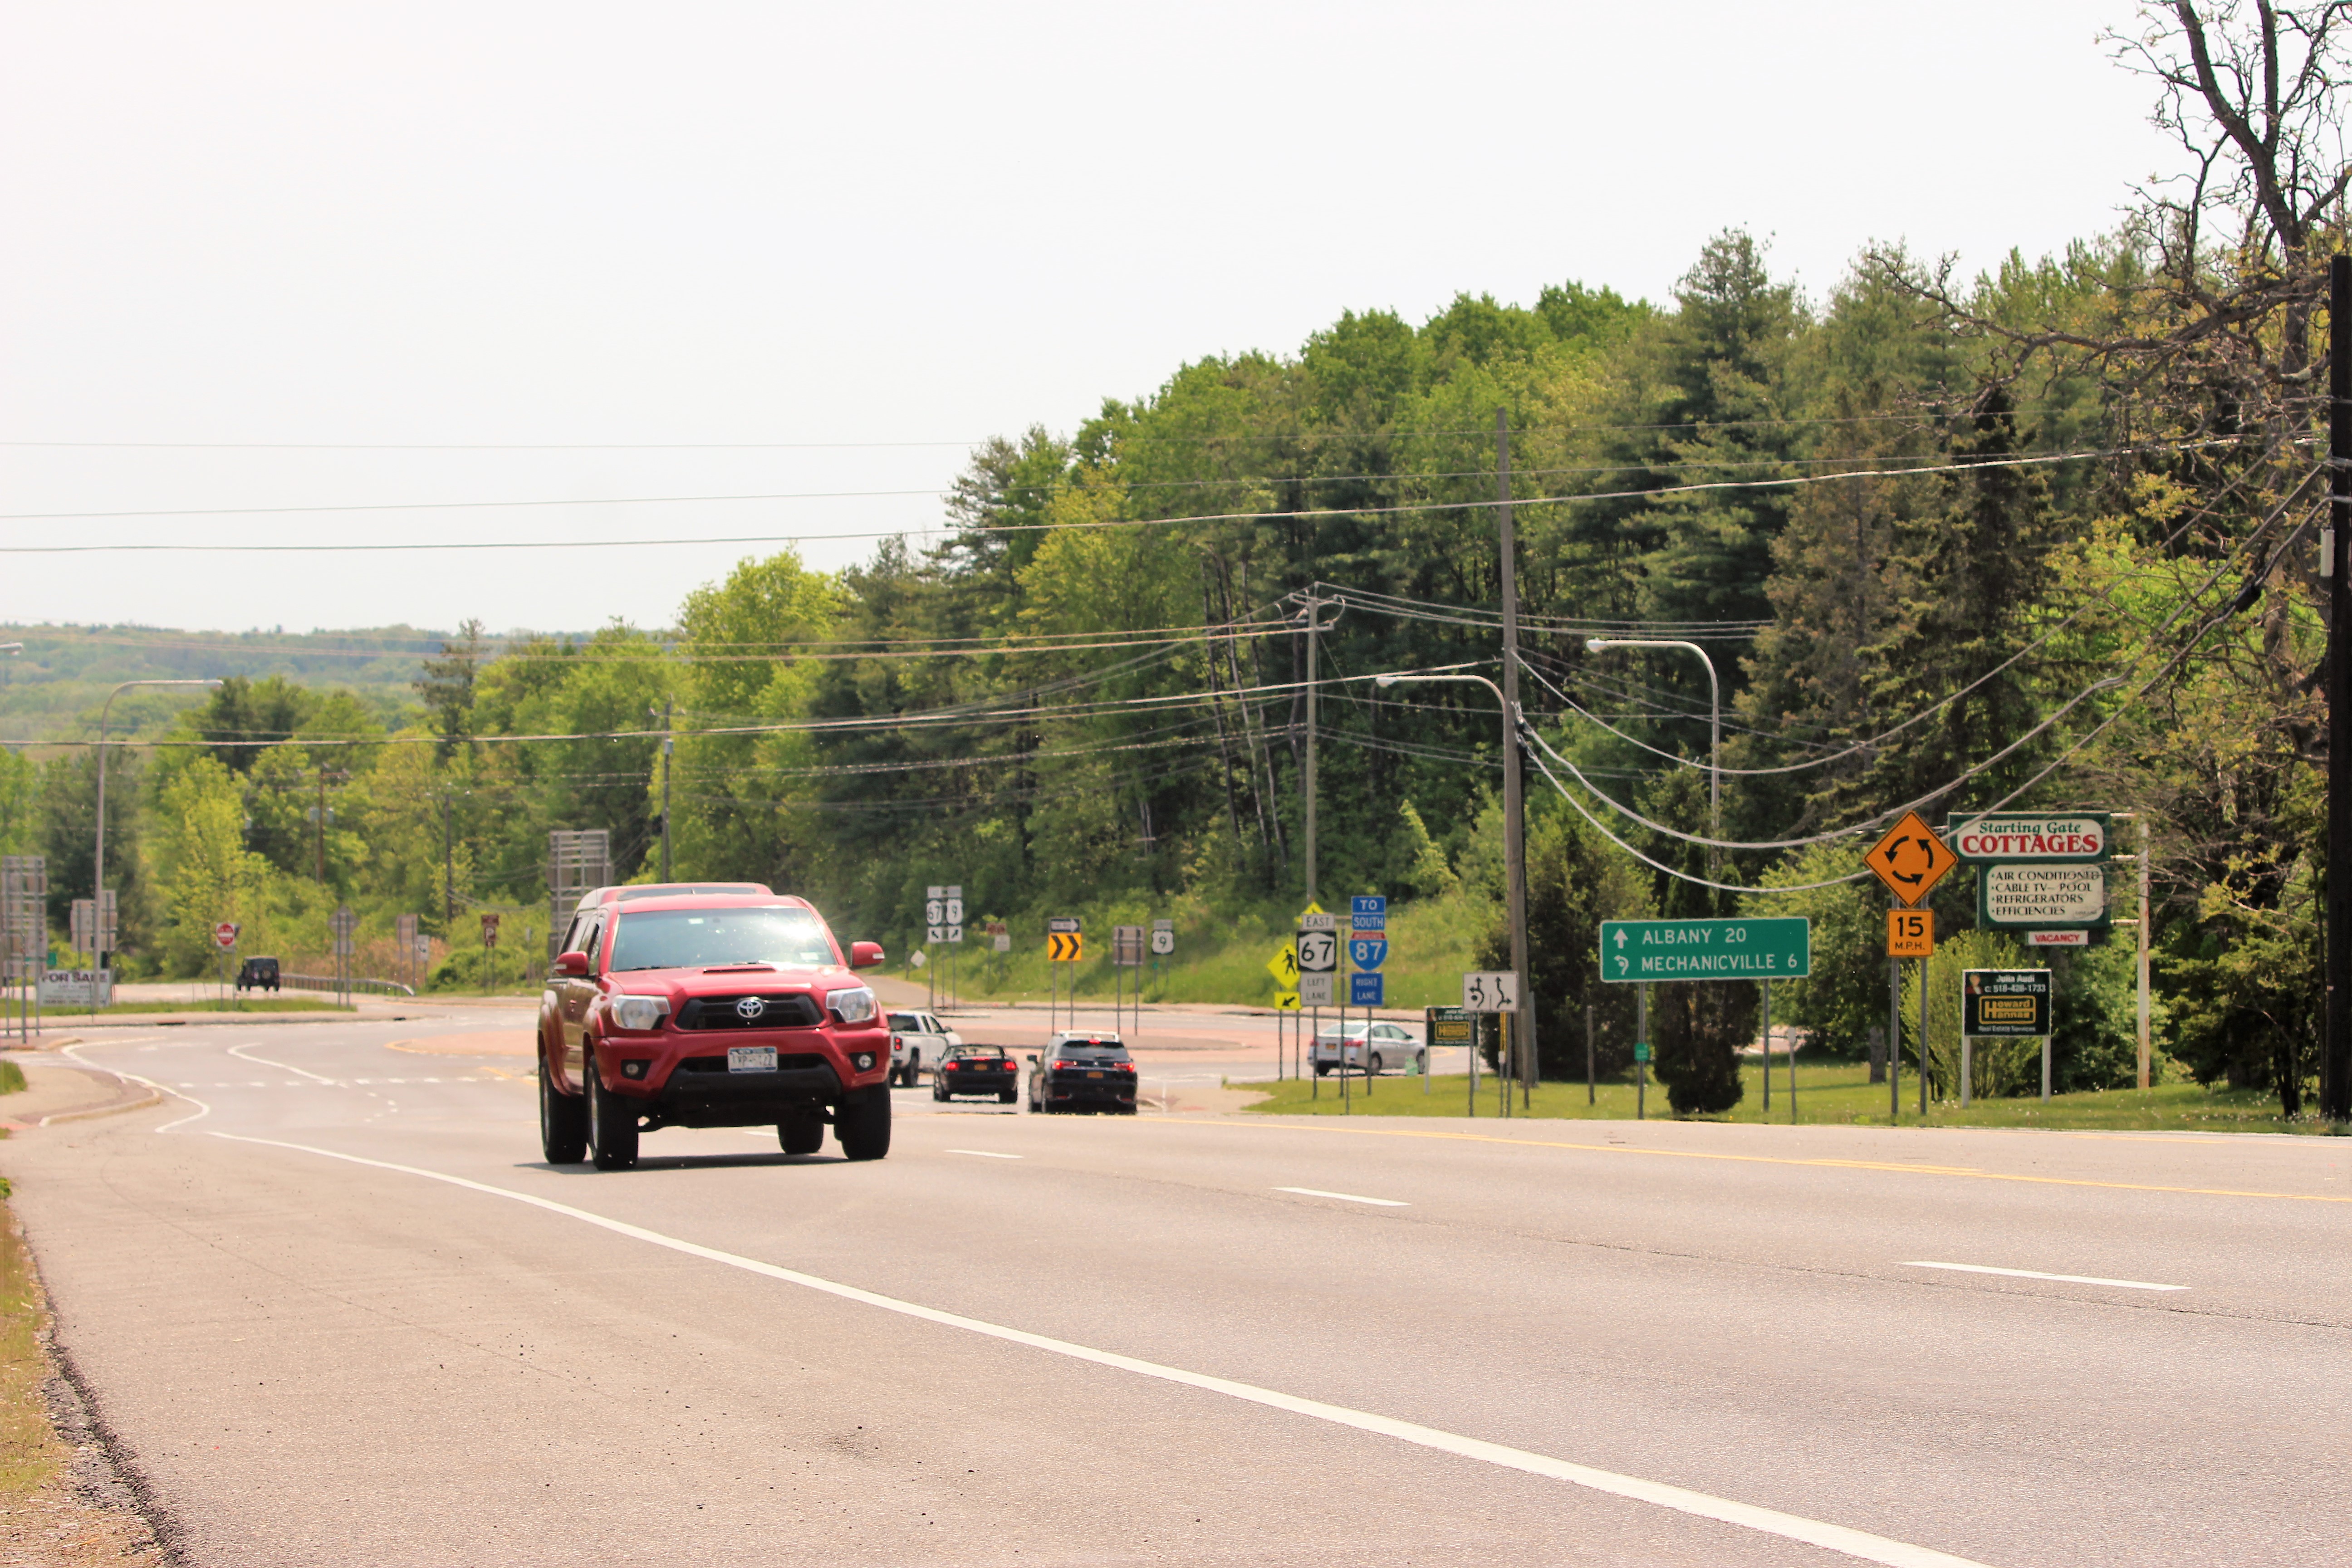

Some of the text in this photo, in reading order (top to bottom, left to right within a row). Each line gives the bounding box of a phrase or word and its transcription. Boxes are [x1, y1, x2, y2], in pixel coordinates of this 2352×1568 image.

[1980, 822, 2081, 835] Starting Gate
[1962, 834, 2098, 853] COTTAGES
[1996, 870, 2100, 881] AIR CONDITIONED
[1995, 883, 2029, 892] CABLE
[2060, 882, 2092, 892] POOL
[1360, 899, 1377, 911] TO
[1996, 894, 2084, 903] REFRIGERATORS
[927, 905, 940, 920] 67
[952, 905, 958, 918] 9
[1996, 906, 2066, 916] EFFICIENCIES
[1306, 916, 1329, 927] EAST
[1354, 916, 1384, 929] SOUTH
[1897, 916, 1924, 937] 15
[1159, 936, 1166, 949] 9
[1642, 927, 1747, 945] ALBANY 20
[2035, 934, 2080, 943] VACANCY
[1301, 941, 1333, 962] 67
[1356, 941, 1382, 961] 87
[1641, 953, 1798, 972] MECHANICVILLE 6
[1355, 978, 1377, 987] RIGHT
[1306, 991, 1326, 1000] LANE
[1357, 991, 1376, 1000] LANE
